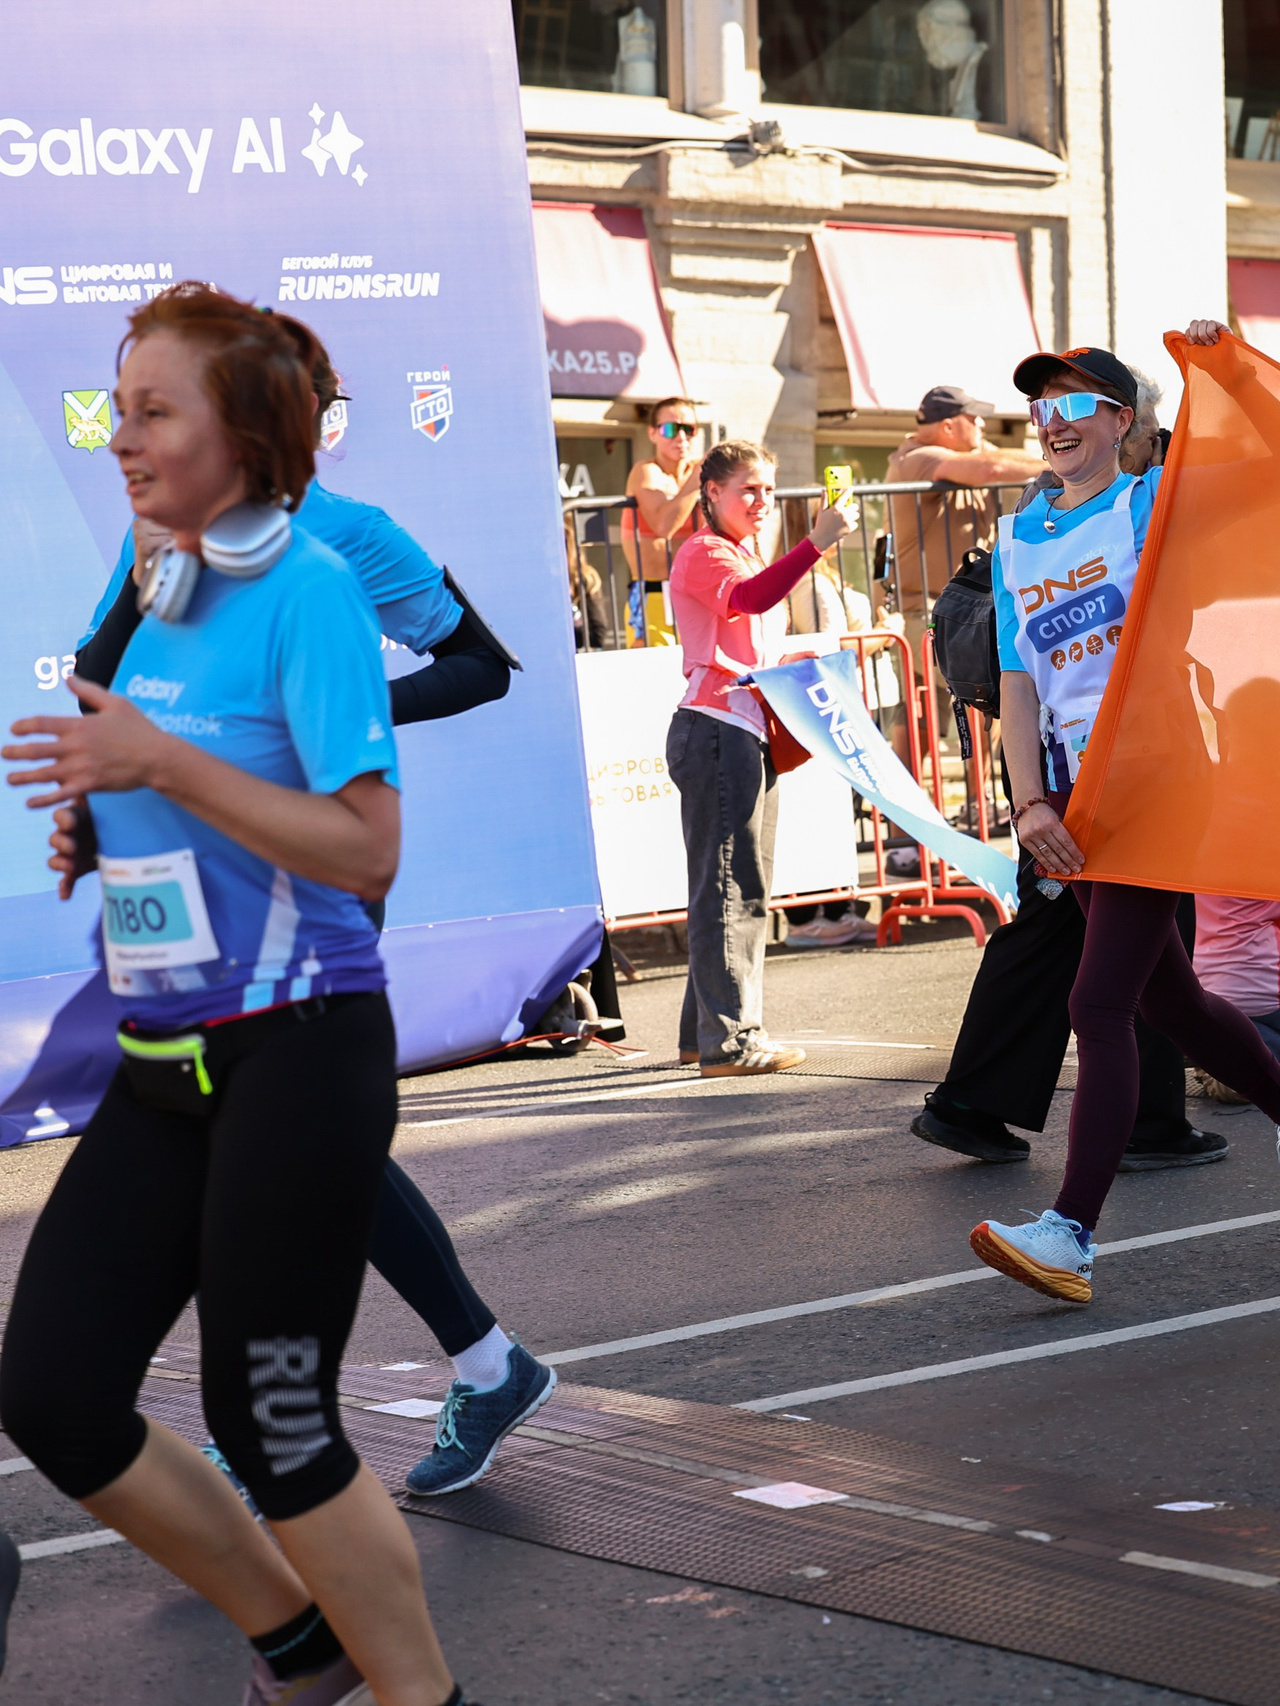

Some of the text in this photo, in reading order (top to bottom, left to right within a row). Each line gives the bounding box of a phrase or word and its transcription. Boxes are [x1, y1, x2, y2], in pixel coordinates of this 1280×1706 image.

[0, 117, 286, 194] Galaxy AI
[60, 262, 173, 284] ЦИФРОВАЯ И
[281, 253, 373, 271] БЕГОВОЙ КЛУБ
[62, 284, 141, 304] БЫТОВАЯ
[278, 272, 441, 302] RUNDNSRUN
[406, 365, 451, 383] ГЕРОЙ
[416, 397, 448, 423] ГТО
[1018, 556, 1108, 615] DNS
[1038, 595, 1106, 639] СПОРТ
[806, 680, 864, 757] DNS
[247, 1336, 332, 1476] RUN
